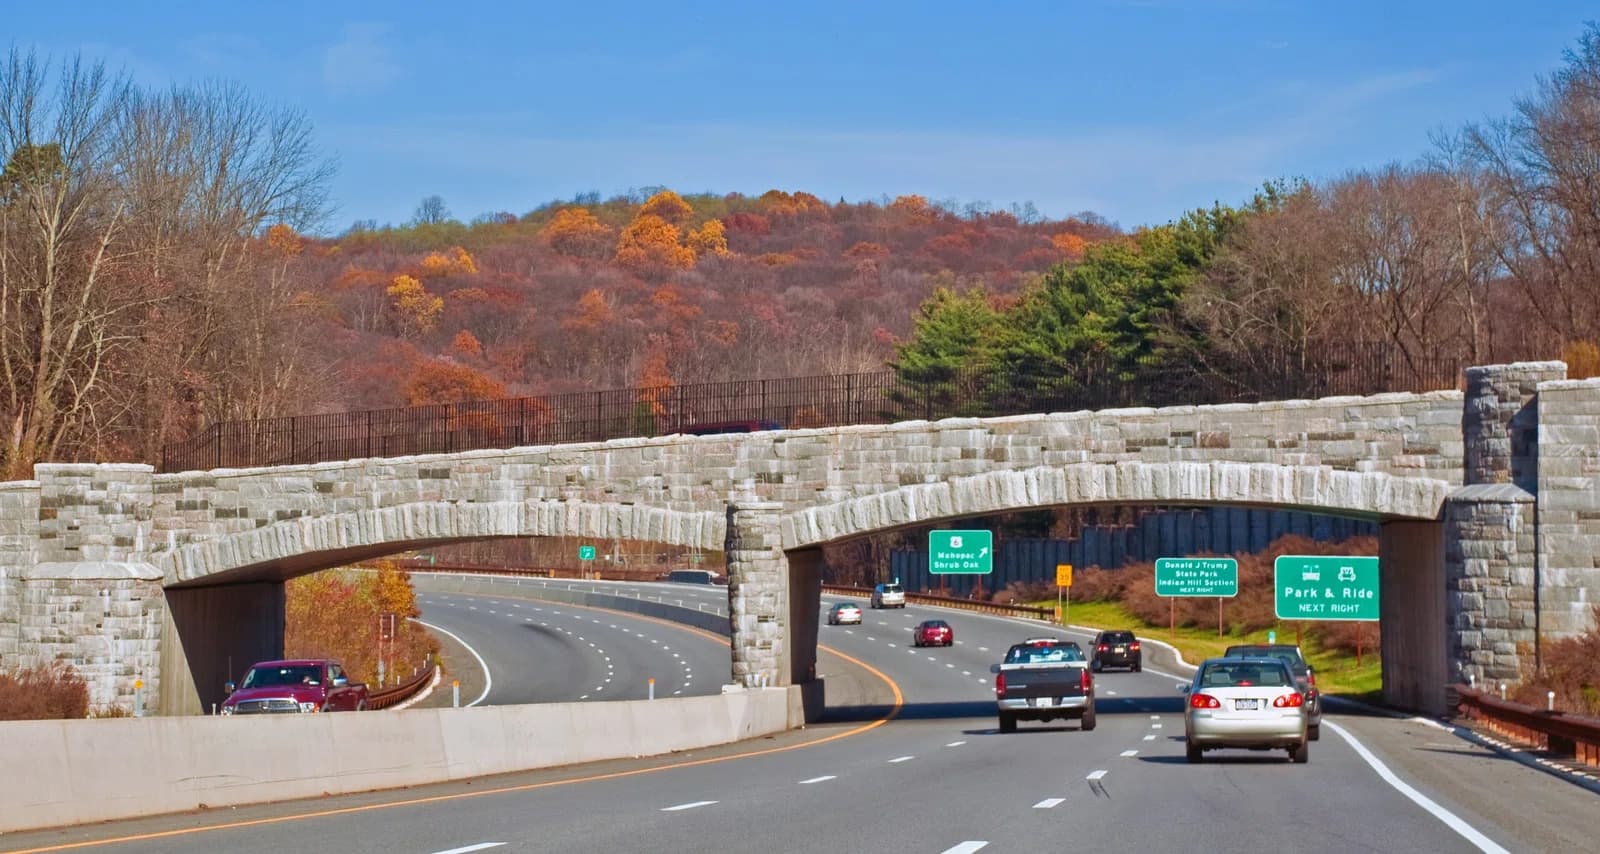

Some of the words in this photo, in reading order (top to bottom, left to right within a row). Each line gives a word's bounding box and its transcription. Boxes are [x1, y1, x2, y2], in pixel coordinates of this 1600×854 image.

[934, 561, 960, 569] Shrub
[963, 561, 979, 569] Oak
[1165, 561, 1193, 569] Donald
[1202, 562, 1228, 570] Trump
[1284, 587, 1318, 598] Park
[1325, 588, 1335, 598] &
[1343, 588, 1373, 598] Ride
[1299, 604, 1325, 613] NEXT
[1331, 604, 1360, 613] RIGHT
